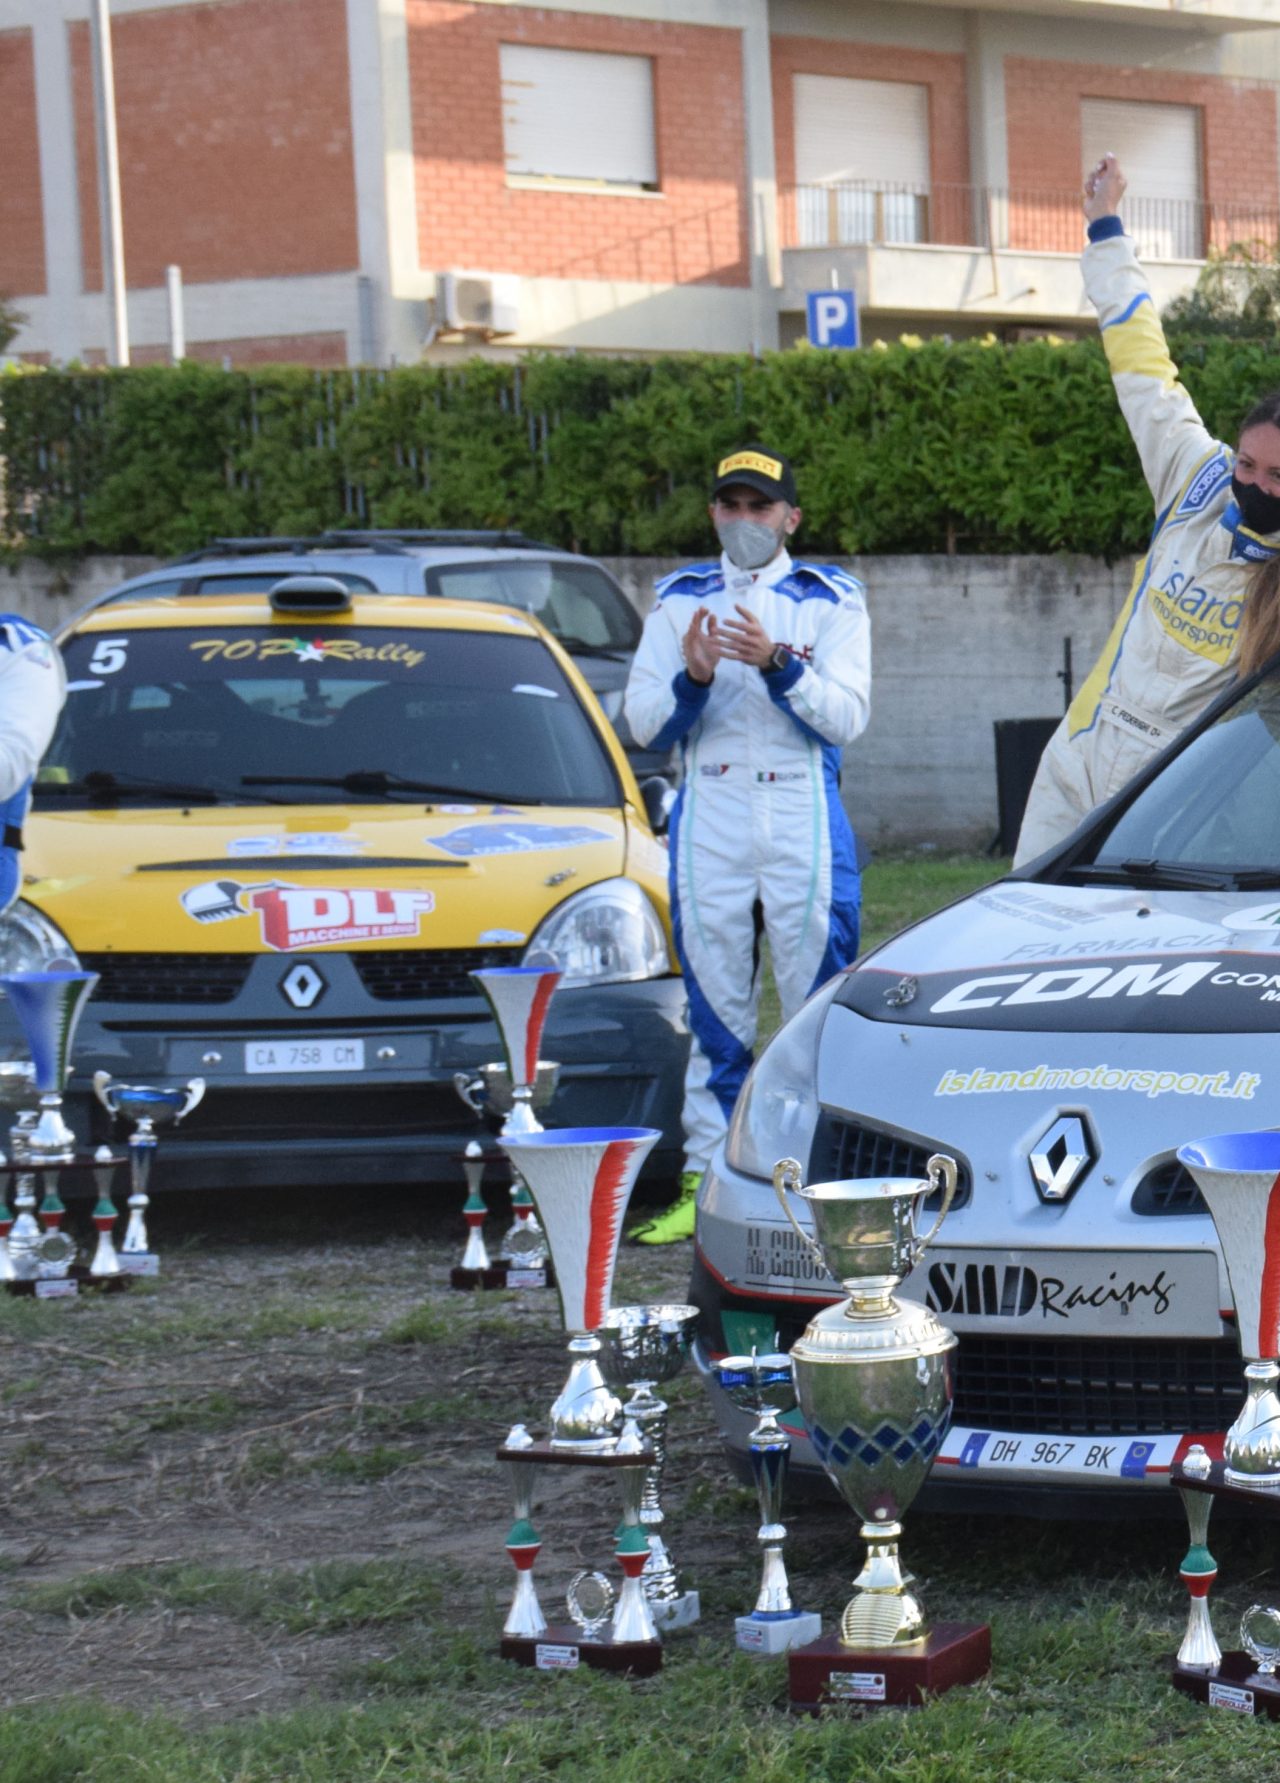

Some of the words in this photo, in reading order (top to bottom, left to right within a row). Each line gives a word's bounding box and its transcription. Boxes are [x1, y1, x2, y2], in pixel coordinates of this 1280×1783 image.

[816, 297, 847, 345] P
[1153, 596, 1234, 649] moorsport
[88, 638, 129, 674] 5
[189, 638, 300, 662] TOP
[318, 639, 425, 668] Rally
[278, 889, 431, 932] DLF
[288, 926, 369, 946] MACCHINE
[1002, 932, 1239, 961] FARMACIA
[930, 961, 1222, 1013] CDM
[255, 1049, 277, 1066] CA
[289, 1047, 322, 1065] 758
[334, 1047, 356, 1063] CM
[935, 1063, 1261, 1100] islandmotorsport.it
[1040, 1269, 1177, 1318] Racing
[990, 1441, 1022, 1463] DH
[1031, 1442, 1075, 1466] 967
[1084, 1445, 1117, 1469] BK
